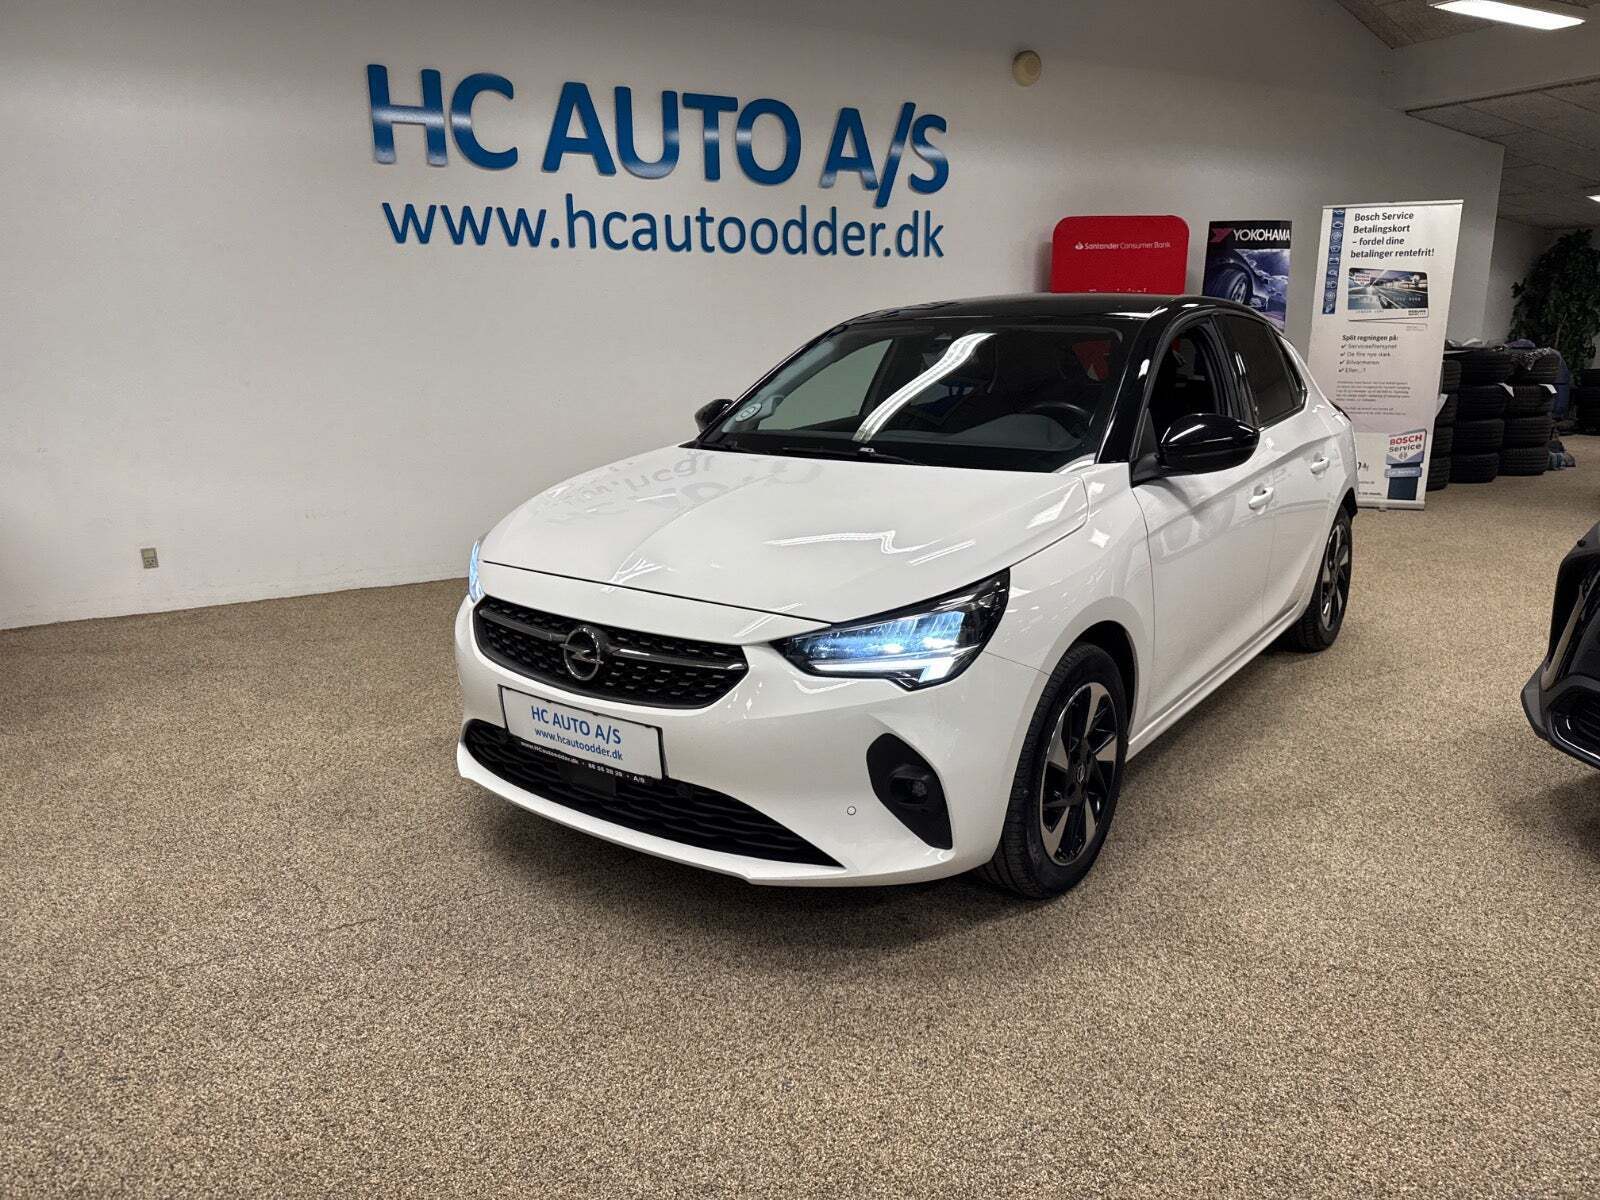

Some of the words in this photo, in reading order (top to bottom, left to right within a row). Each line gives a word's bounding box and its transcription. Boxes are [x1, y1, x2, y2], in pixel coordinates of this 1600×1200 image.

[366, 64, 518, 170] HC
[541, 81, 801, 186] AUTO
[817, 102, 950, 208] A/S
[1354, 212, 1380, 222] Bosch
[1382, 211, 1414, 221] Service
[382, 193, 945, 257] www.hcautoodder.dk
[1353, 224, 1410, 235] Betalingskort
[1232, 228, 1291, 242] YOKOHAMA
[1359, 236, 1384, 246] fordel
[1385, 236, 1405, 246] dine
[1084, 241, 1119, 250] Santander
[1120, 241, 1153, 250] Consumer
[1154, 241, 1171, 249] Bank
[1350, 249, 1393, 260] betalinger
[1395, 248, 1435, 258] rentefrit!
[1389, 434, 1423, 446] BOSCH
[1388, 443, 1422, 453] Service
[531, 705, 550, 724] HC
[552, 712, 591, 736] AUTO
[595, 725, 622, 745] A/S
[535, 727, 624, 761] www.hcautoodder.dk
